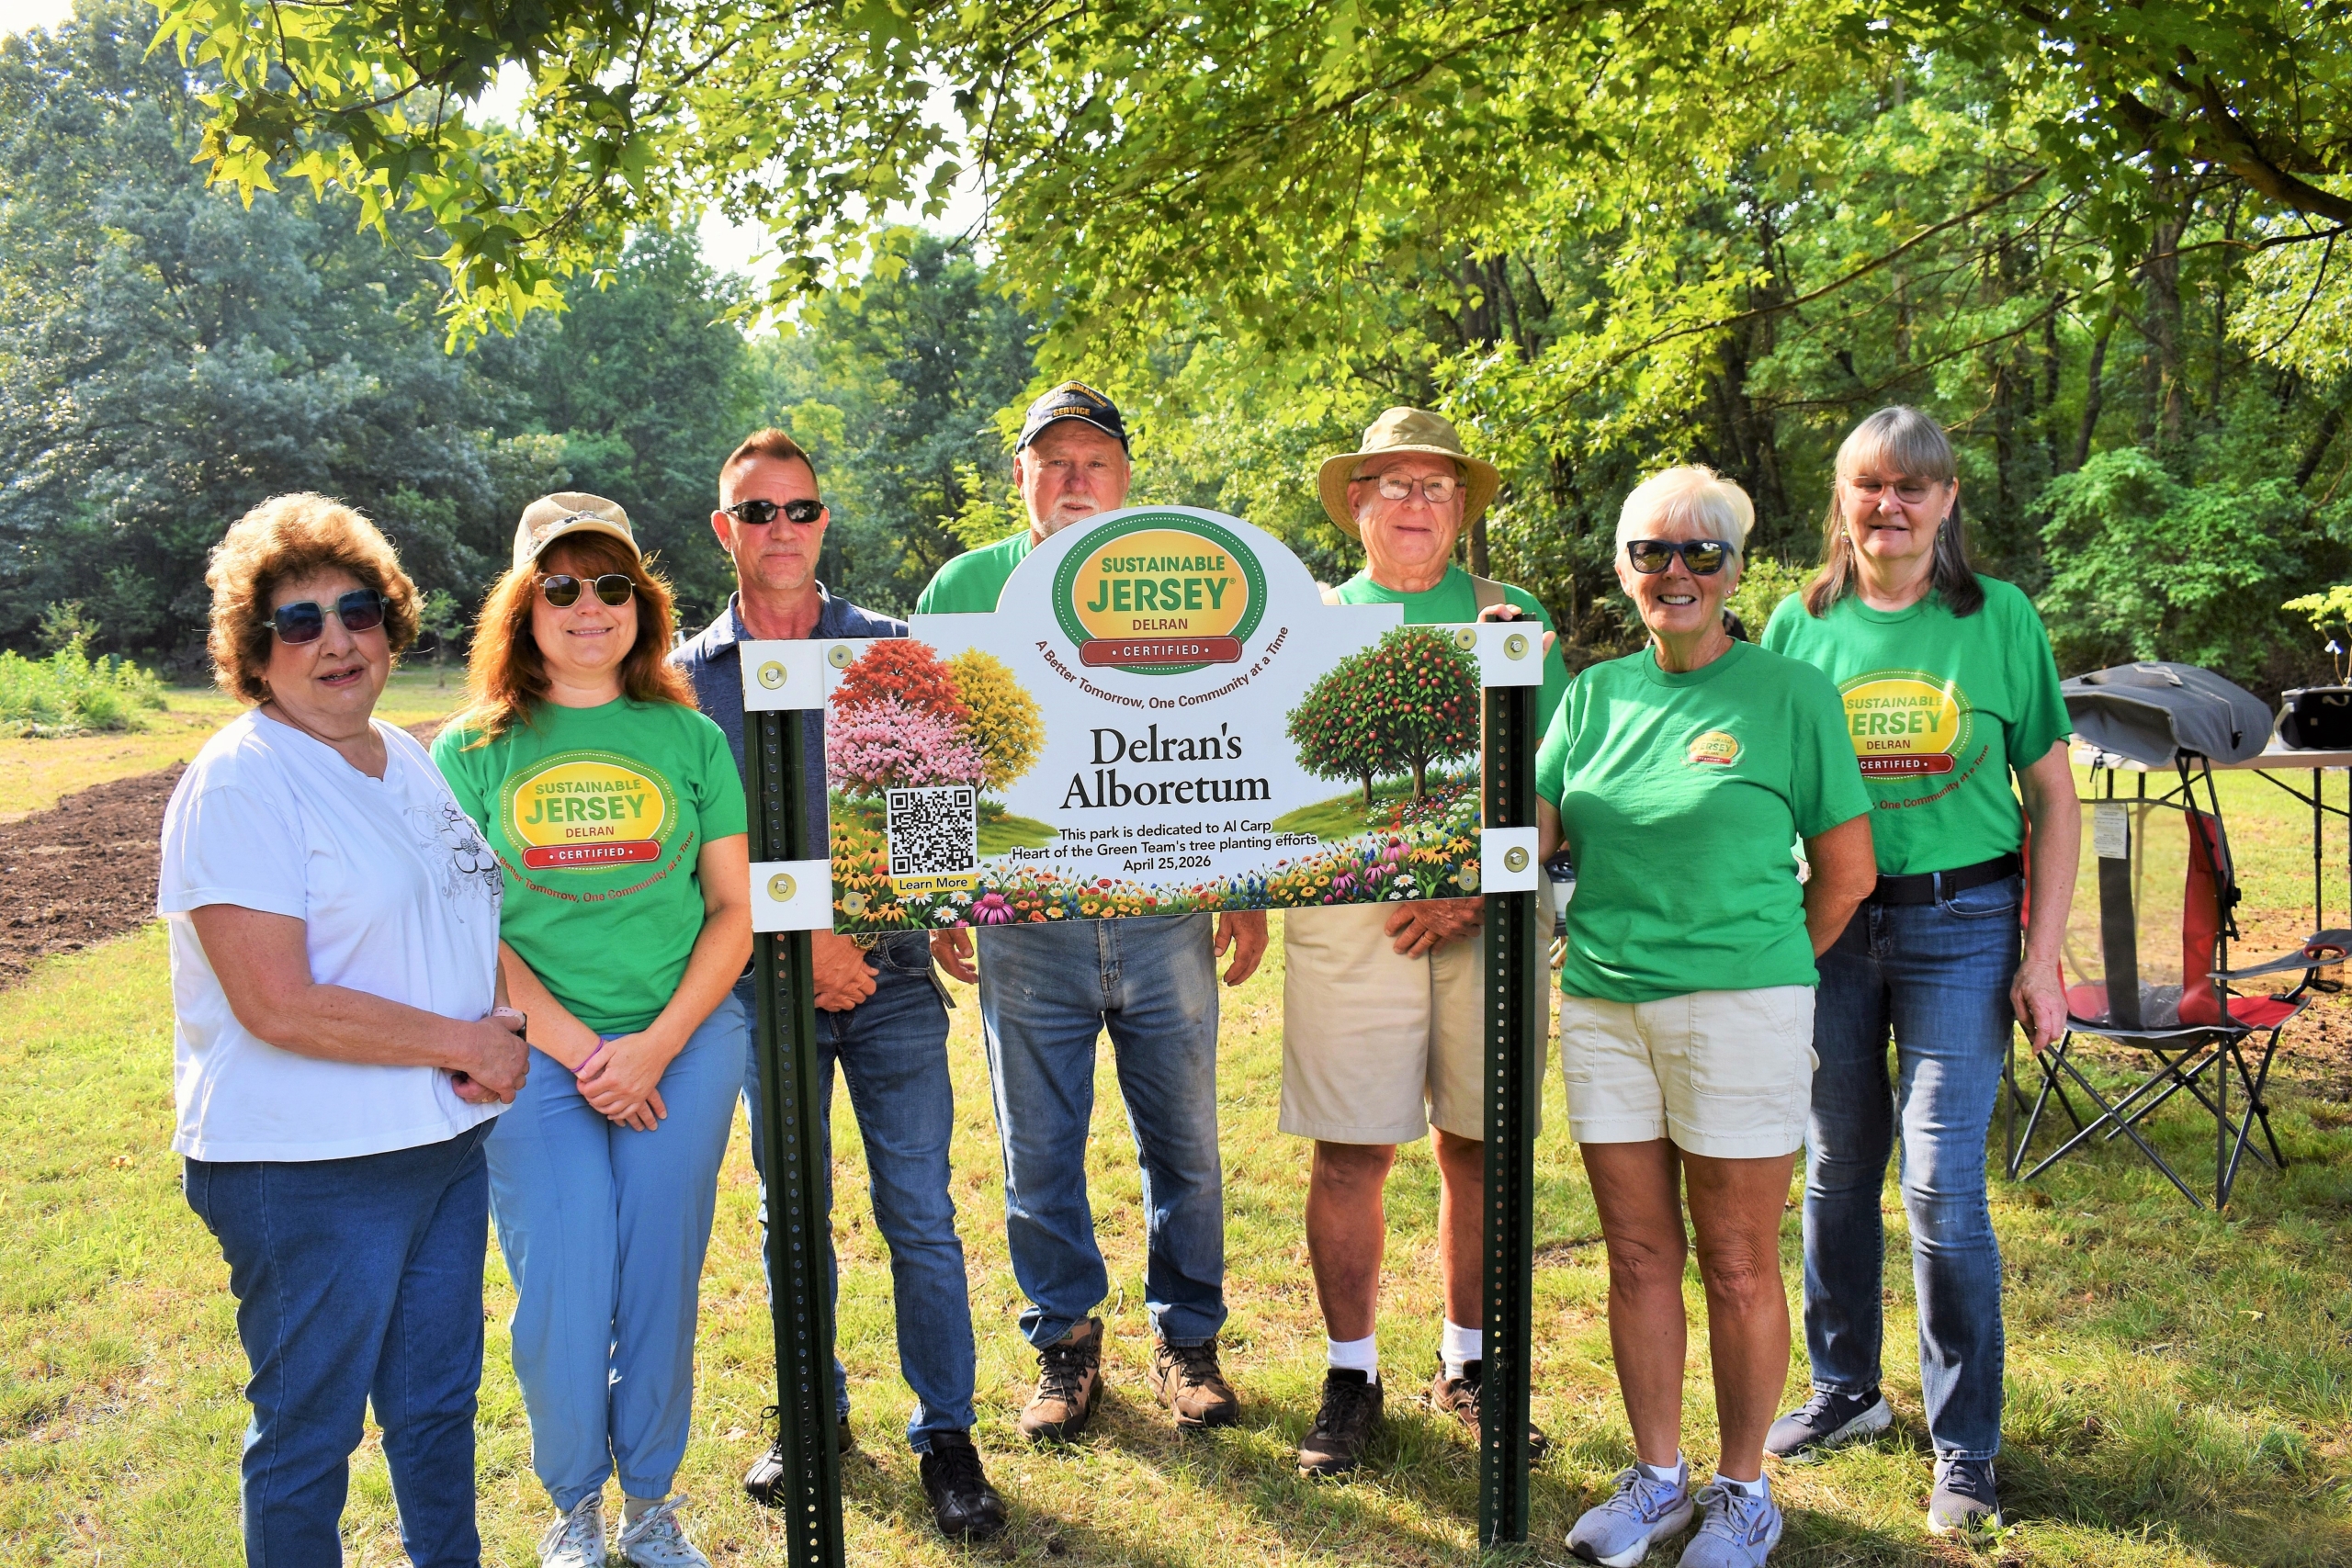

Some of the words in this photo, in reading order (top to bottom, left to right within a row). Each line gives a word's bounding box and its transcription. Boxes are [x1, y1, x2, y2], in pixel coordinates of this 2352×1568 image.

[1060, 383, 1108, 408] SUBMARINE
[1053, 406, 1090, 416] SERVICE
[1102, 555, 1225, 573] SUSTAINABLE
[1132, 618, 1188, 630] DELRAN
[1035, 641, 1047, 651] A
[1266, 626, 1288, 655] Time
[1123, 645, 1200, 658] CERTIFIED
[1044, 649, 1077, 682] Better
[1250, 662, 1262, 676] at
[1262, 656, 1271, 665] a
[1079, 677, 1145, 709] Tomorrow,
[1178, 673, 1250, 707] Community
[1148, 697, 1175, 709] One
[1846, 696, 1942, 709] SUSTAINABLE
[1845, 711, 1944, 736] ERSEY
[1090, 722, 1242, 764] Delran's
[1867, 739, 1911, 750] DELRAN
[1860, 760, 1920, 770] CERTIFIED
[1880, 800, 1901, 810] One
[1904, 781, 1960, 807] Community
[1960, 773, 1970, 783] at
[1973, 744, 1988, 766] Time
[535, 779, 641, 795] SUSTAINABLE
[1058, 768, 1272, 809] Alboretum
[566, 827, 614, 838] DELRAN
[1059, 829, 1086, 840] This
[1090, 827, 1119, 842] park
[1123, 827, 1133, 838] is
[1137, 822, 1202, 837] dedicated
[1205, 823, 1219, 834] to
[1224, 820, 1237, 832] Al
[1240, 820, 1272, 834] Carp
[559, 847, 625, 860] CERTIFIED
[1012, 847, 1049, 860] Heart
[1055, 845, 1068, 858] of
[1071, 845, 1093, 856] the
[1097, 843, 1137, 856] Green
[1141, 840, 1185, 853] Team's
[1189, 840, 1216, 851] tree
[1220, 837, 1272, 852] planting
[1275, 833, 1317, 847] efforts
[500, 856, 523, 882] Better
[526, 878, 579, 903] Tomorrow,
[582, 892, 605, 902] One
[607, 869, 667, 898] Community
[667, 860, 676, 871] at
[679, 830, 694, 852] Time
[1123, 858, 1154, 874] April
[1158, 855, 1211, 871] 25,2026
[899, 880, 932, 889] Learn
[937, 877, 968, 887] More
